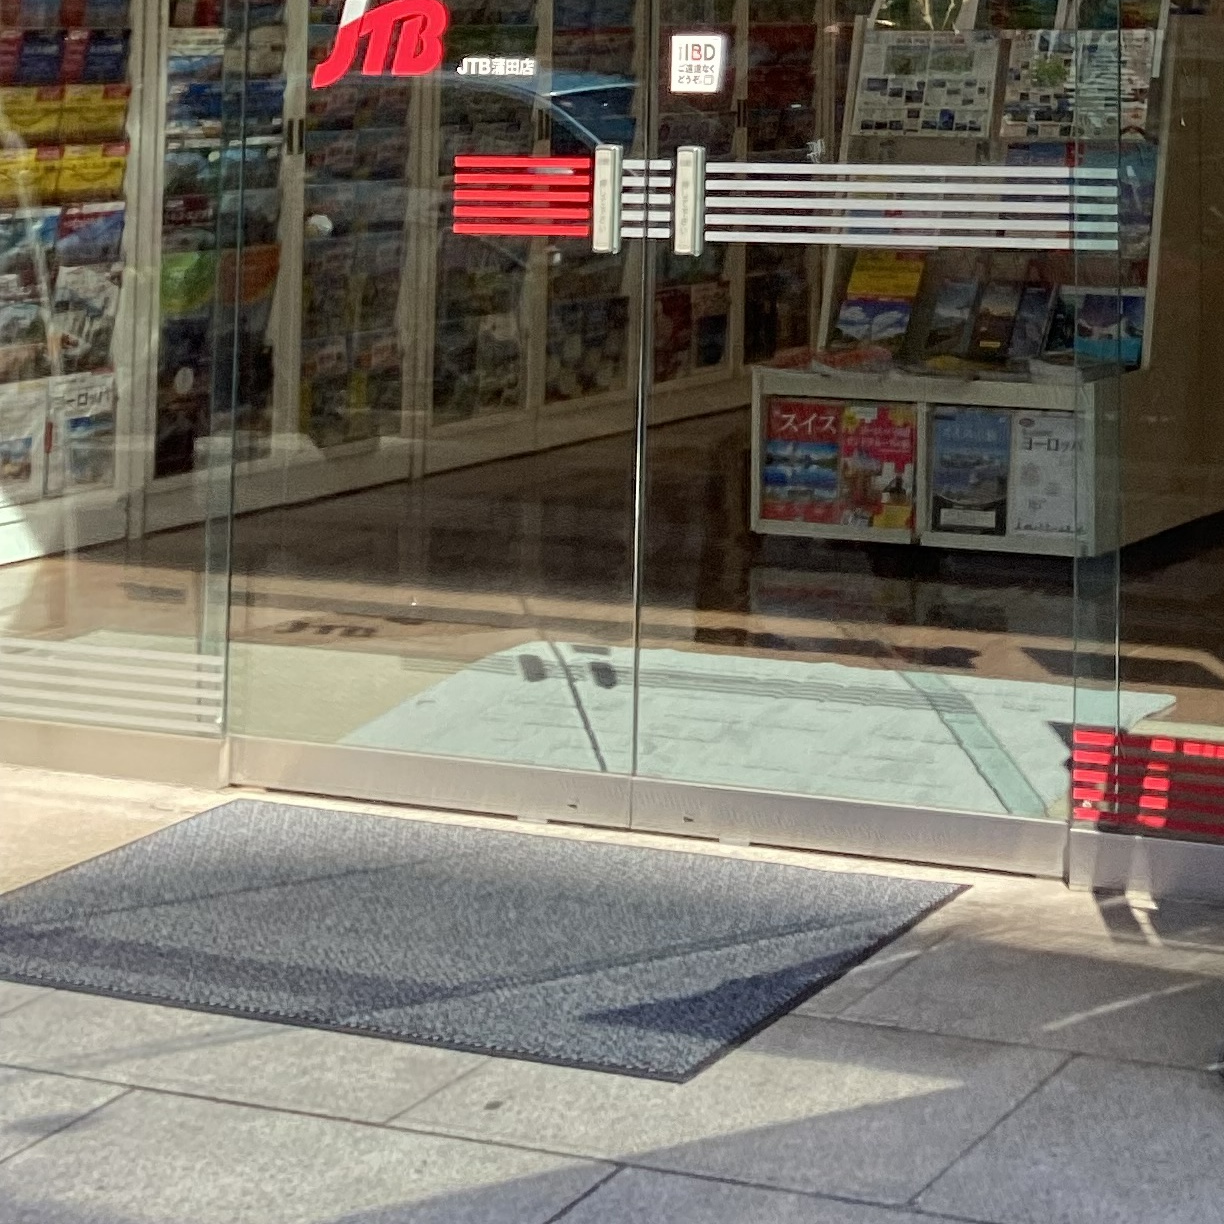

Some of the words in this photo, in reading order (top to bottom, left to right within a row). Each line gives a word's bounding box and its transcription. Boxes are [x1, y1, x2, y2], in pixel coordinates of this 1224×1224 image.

[456, 57, 535, 76] JTB蒲田店
[779, 412, 838, 435] スイス
